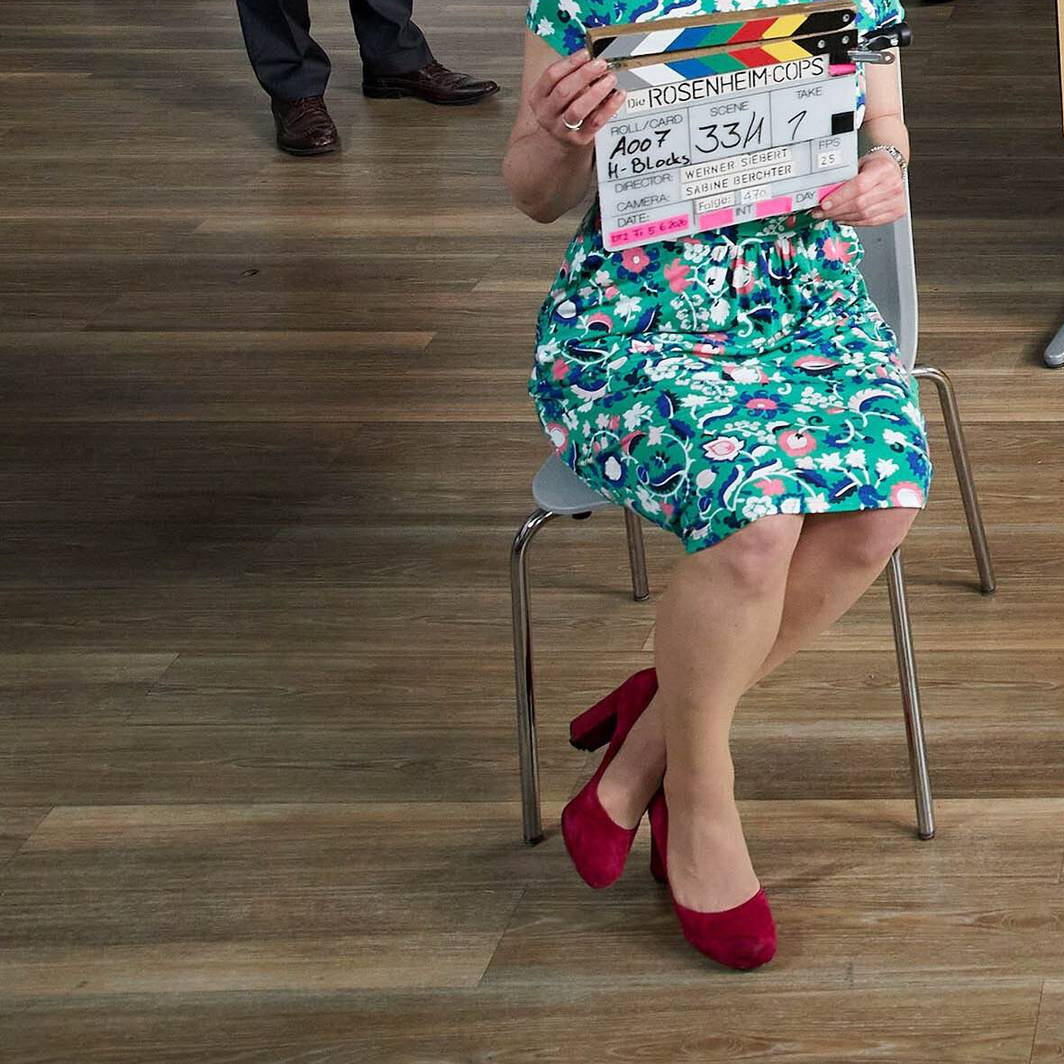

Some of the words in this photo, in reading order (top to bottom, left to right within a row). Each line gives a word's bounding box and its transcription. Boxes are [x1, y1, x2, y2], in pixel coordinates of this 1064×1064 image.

[627, 97, 646, 109] Die
[649, 57, 824, 108] ROSENHEIM-COPS
[795, 86, 823, 100] TAKE
[710, 101, 749, 117] SCENE
[610, 114, 683, 136] ROLL/CARD
[818, 138, 841, 150] FPS
[684, 160, 735, 180] WERNER
[740, 148, 788, 166] SIEBERT
[820, 155, 836, 166] 25
[685, 178, 728, 196] SABINE
[795, 191, 815, 203] DAY
[735, 205, 754, 217] INT
